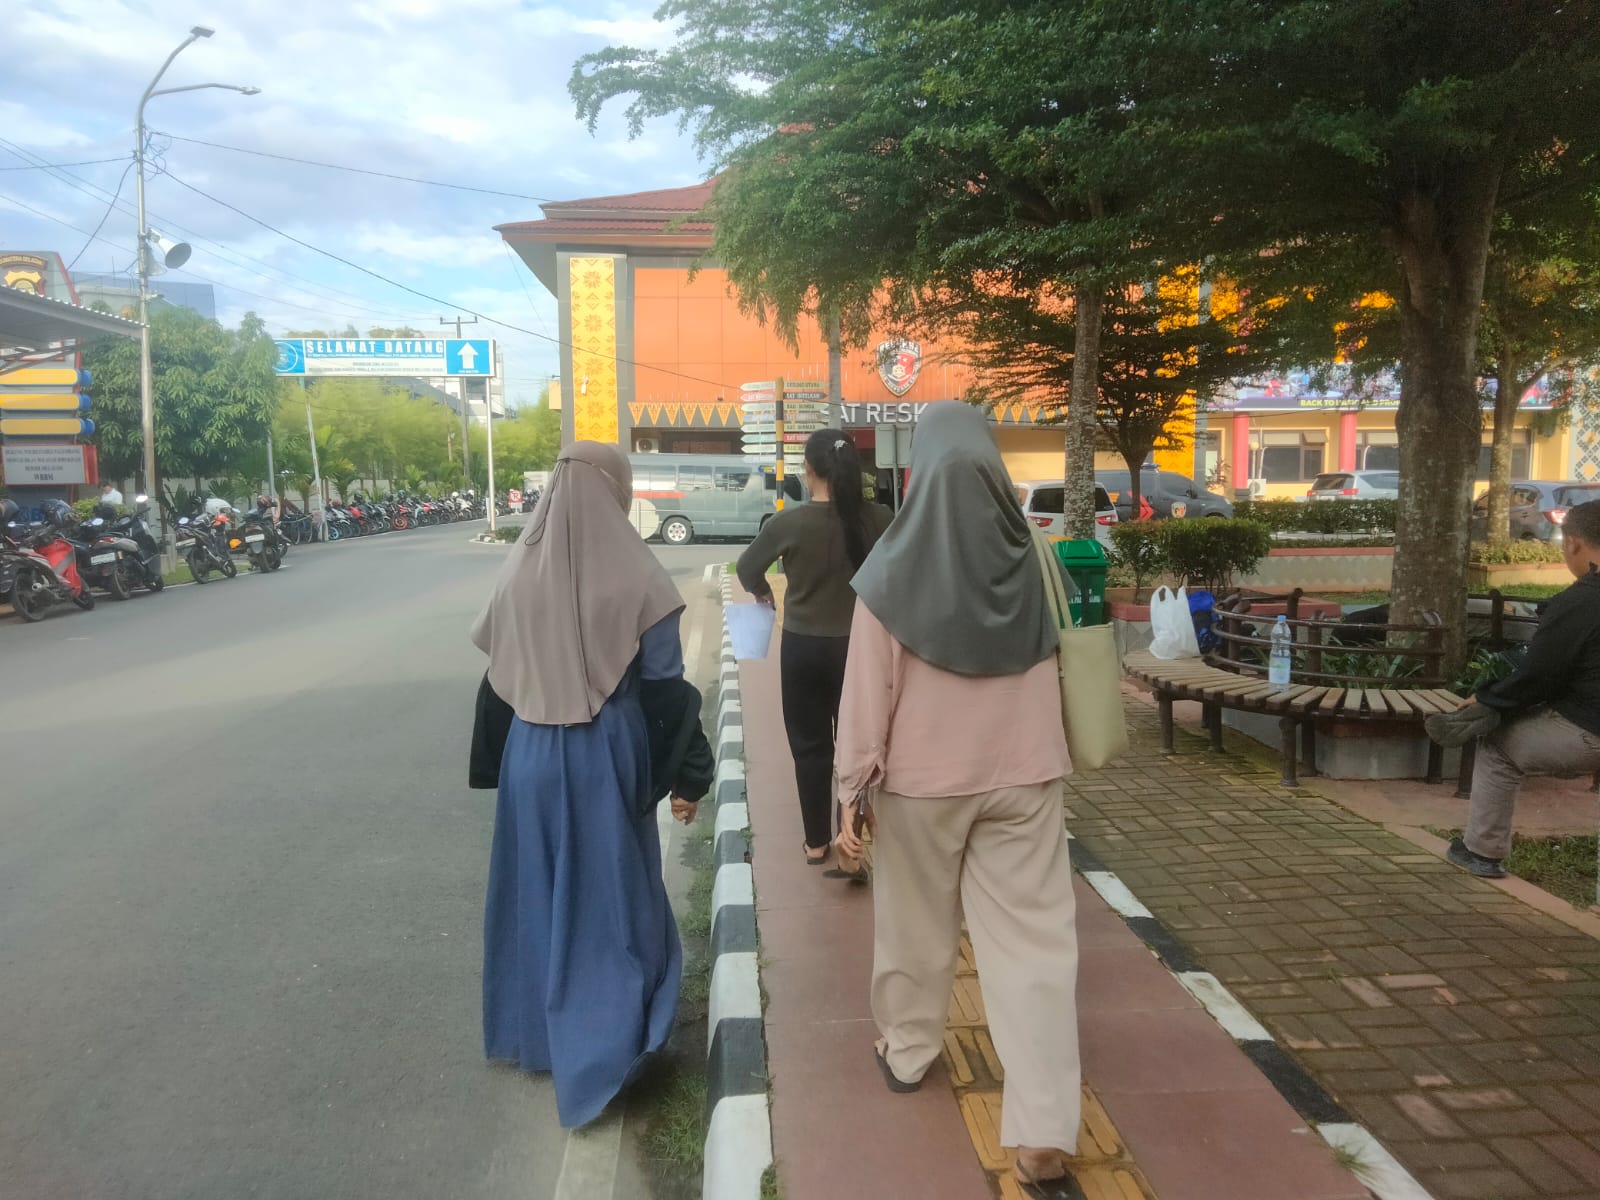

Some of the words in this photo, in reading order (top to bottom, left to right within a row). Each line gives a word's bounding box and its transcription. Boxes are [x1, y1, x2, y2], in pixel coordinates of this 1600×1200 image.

[306, 340, 376, 353] SELAMAT
[384, 340, 444, 353] DATANG
[1300, 399, 1322, 407] BACK
[1324, 399, 1335, 407] TO
